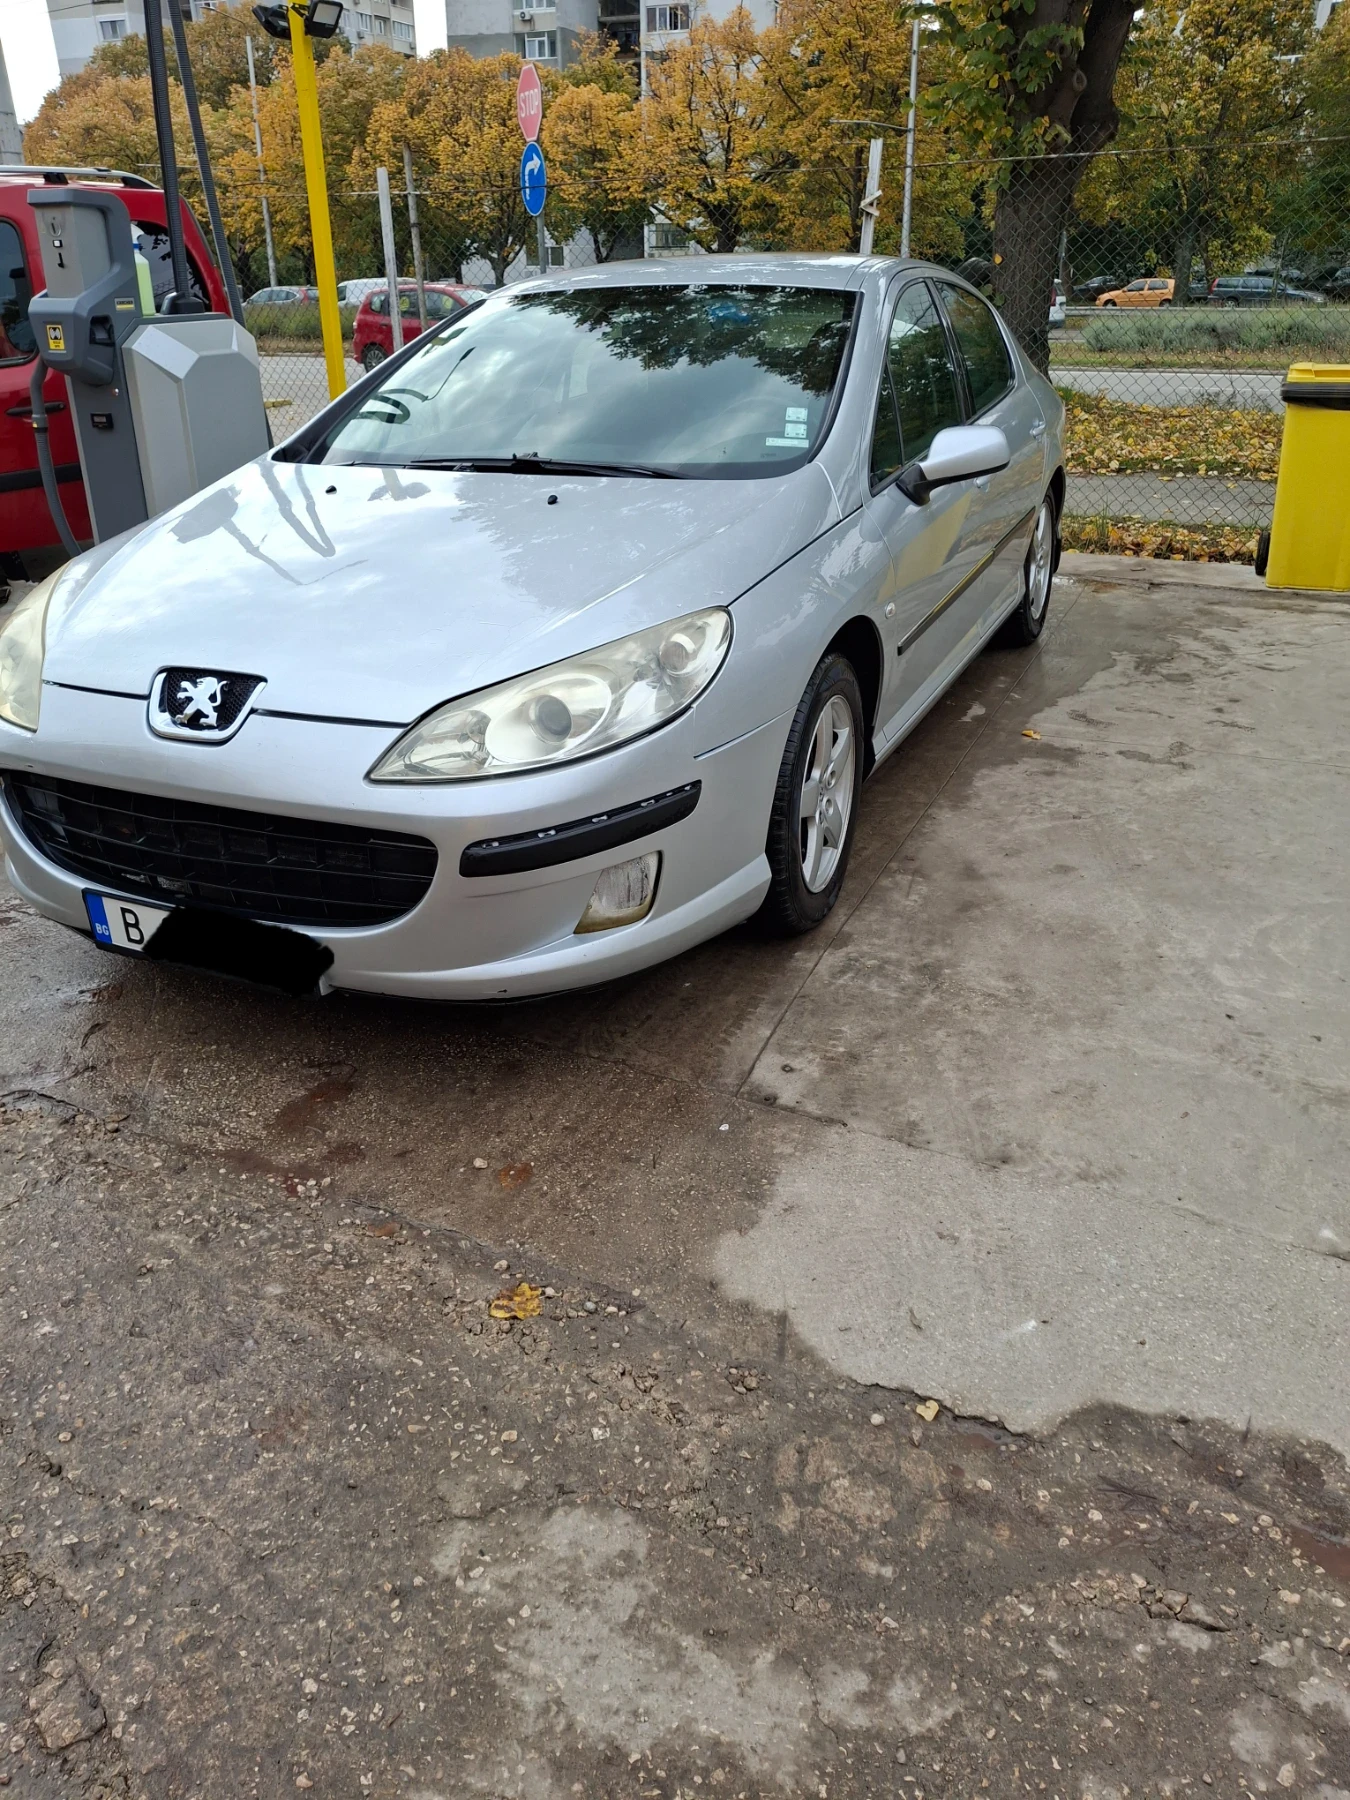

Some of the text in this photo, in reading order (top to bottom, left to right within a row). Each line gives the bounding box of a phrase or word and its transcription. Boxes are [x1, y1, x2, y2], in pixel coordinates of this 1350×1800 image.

[520, 88, 539, 118] STOP
[95, 922, 110, 936] BG
[120, 906, 145, 945] B
